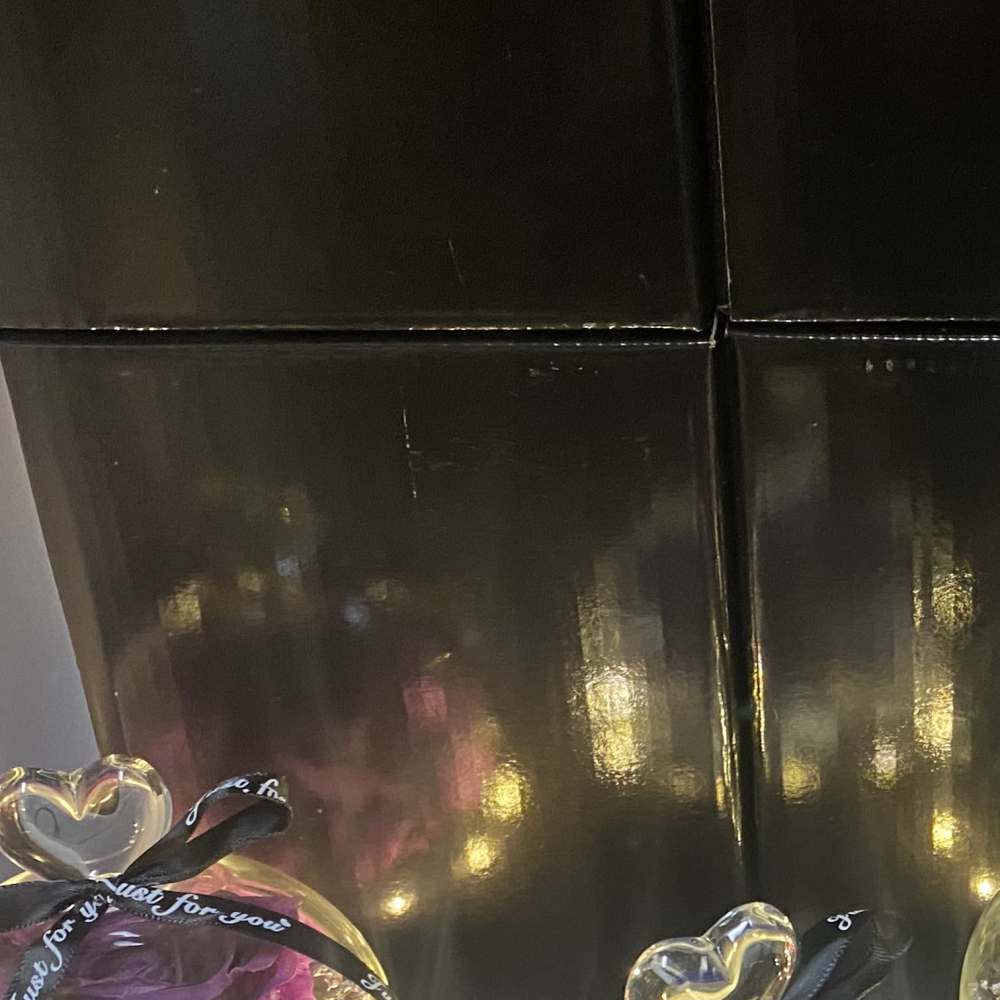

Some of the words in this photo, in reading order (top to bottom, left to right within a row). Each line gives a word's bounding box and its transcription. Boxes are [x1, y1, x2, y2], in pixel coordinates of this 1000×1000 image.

[151, 893, 220, 917] for
[217, 910, 288, 933] you
[42, 918, 77, 973] for
